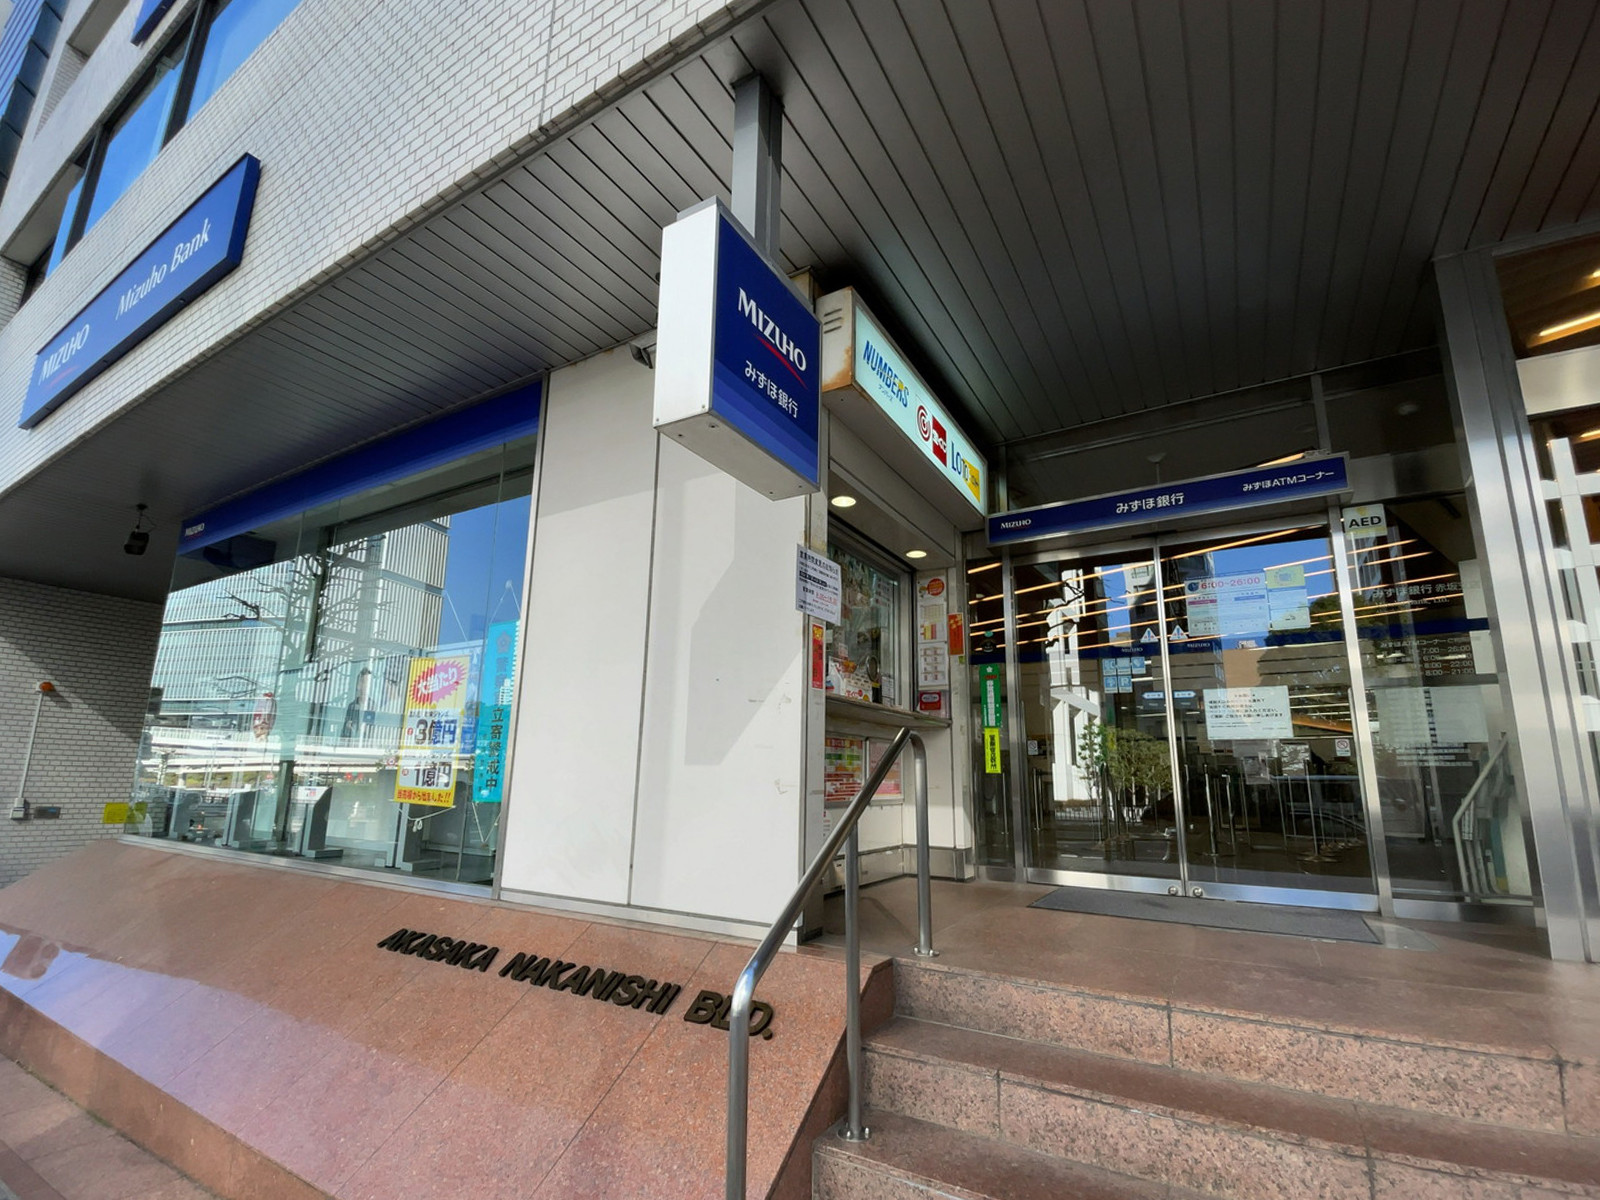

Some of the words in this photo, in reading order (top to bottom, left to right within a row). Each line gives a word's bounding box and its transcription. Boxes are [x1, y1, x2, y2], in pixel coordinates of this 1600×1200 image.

[115, 264, 167, 321] Mizuho
[170, 218, 212, 273] Bank
[738, 287, 807, 371] MIZUHO
[38, 324, 90, 386] MIZUHO
[745, 360, 799, 418] みずほ銀行
[863, 340, 910, 408] NUMBERS
[1242, 470, 1335, 492] みずほATMコーナー
[1116, 493, 1185, 514] みずほ銀行
[1000, 518, 1032, 529] MIZUHO
[1349, 515, 1382, 528] AED
[417, 666, 459, 697] 大当たり
[414, 718, 458, 746] 3億円
[414, 761, 453, 788] 1億円
[376, 928, 500, 972] AKASAKA
[499, 952, 682, 1015] NAKANISHI
